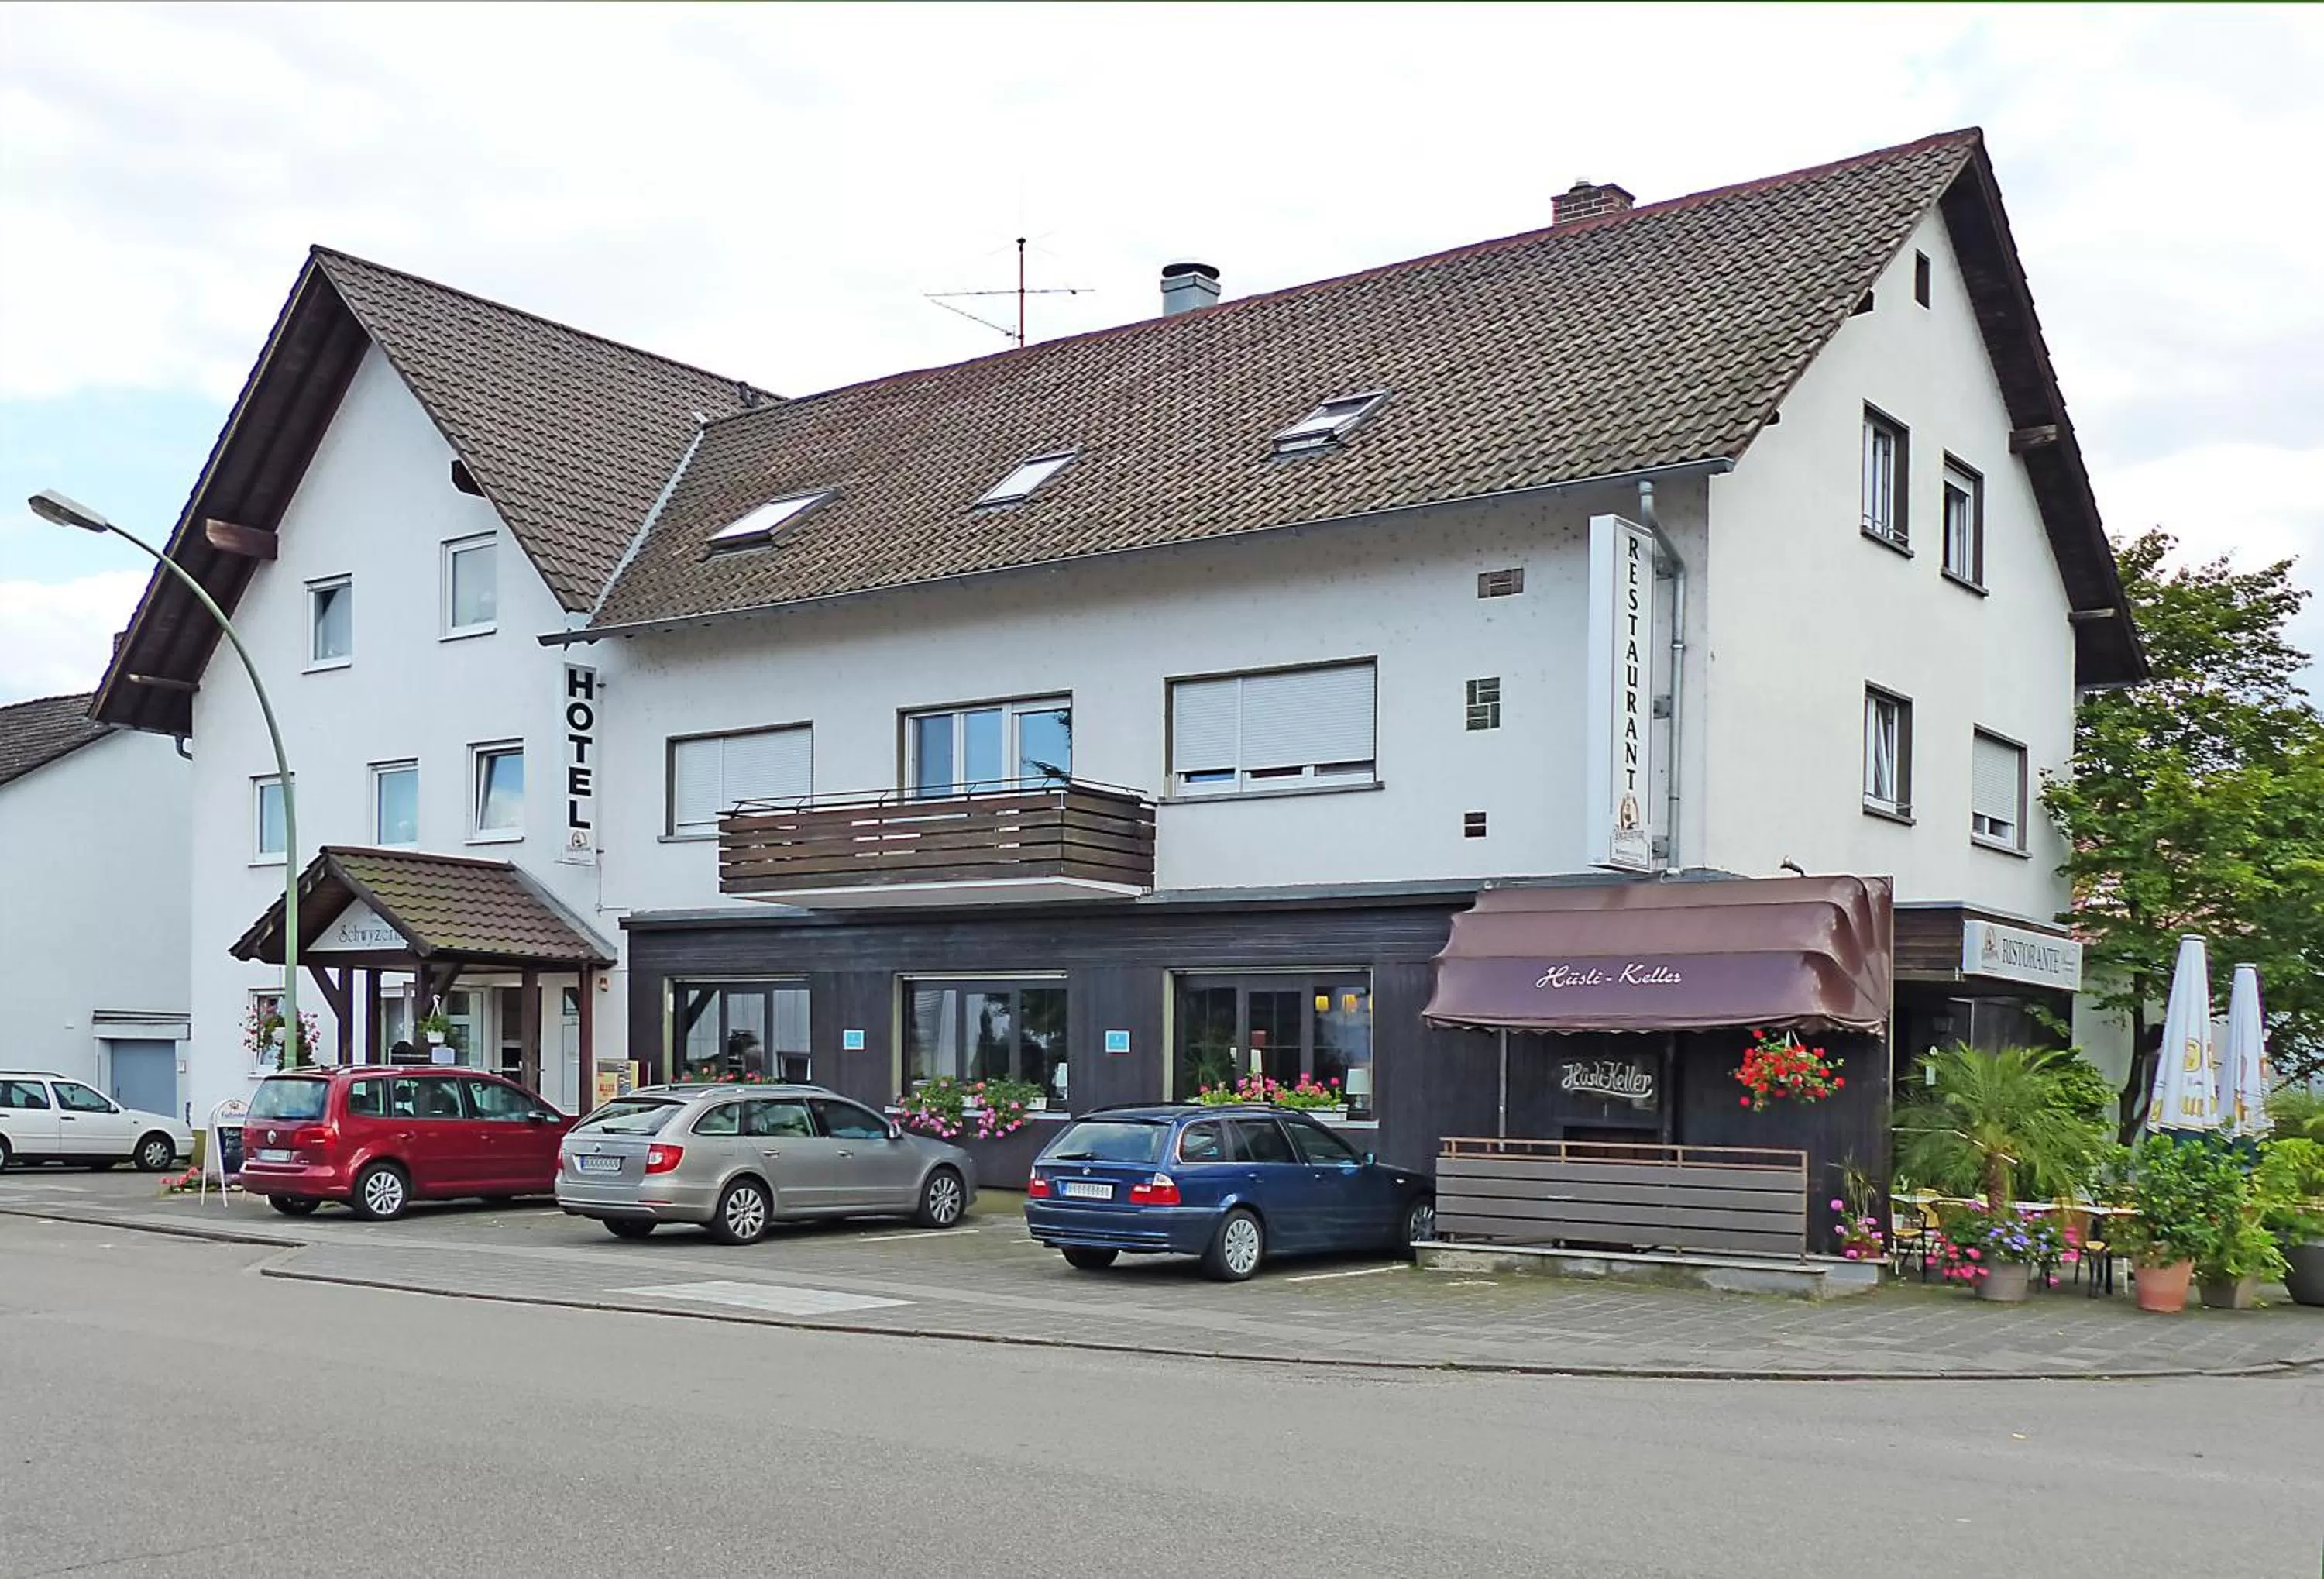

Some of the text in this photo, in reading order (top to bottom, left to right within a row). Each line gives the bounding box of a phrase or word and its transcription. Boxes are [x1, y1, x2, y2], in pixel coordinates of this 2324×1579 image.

[1625, 536, 1639, 790] RESTAURANT
[566, 669, 593, 829] HOTEL
[1618, 963, 1683, 984] Keller
[2003, 938, 2060, 974] RISTORANTE
